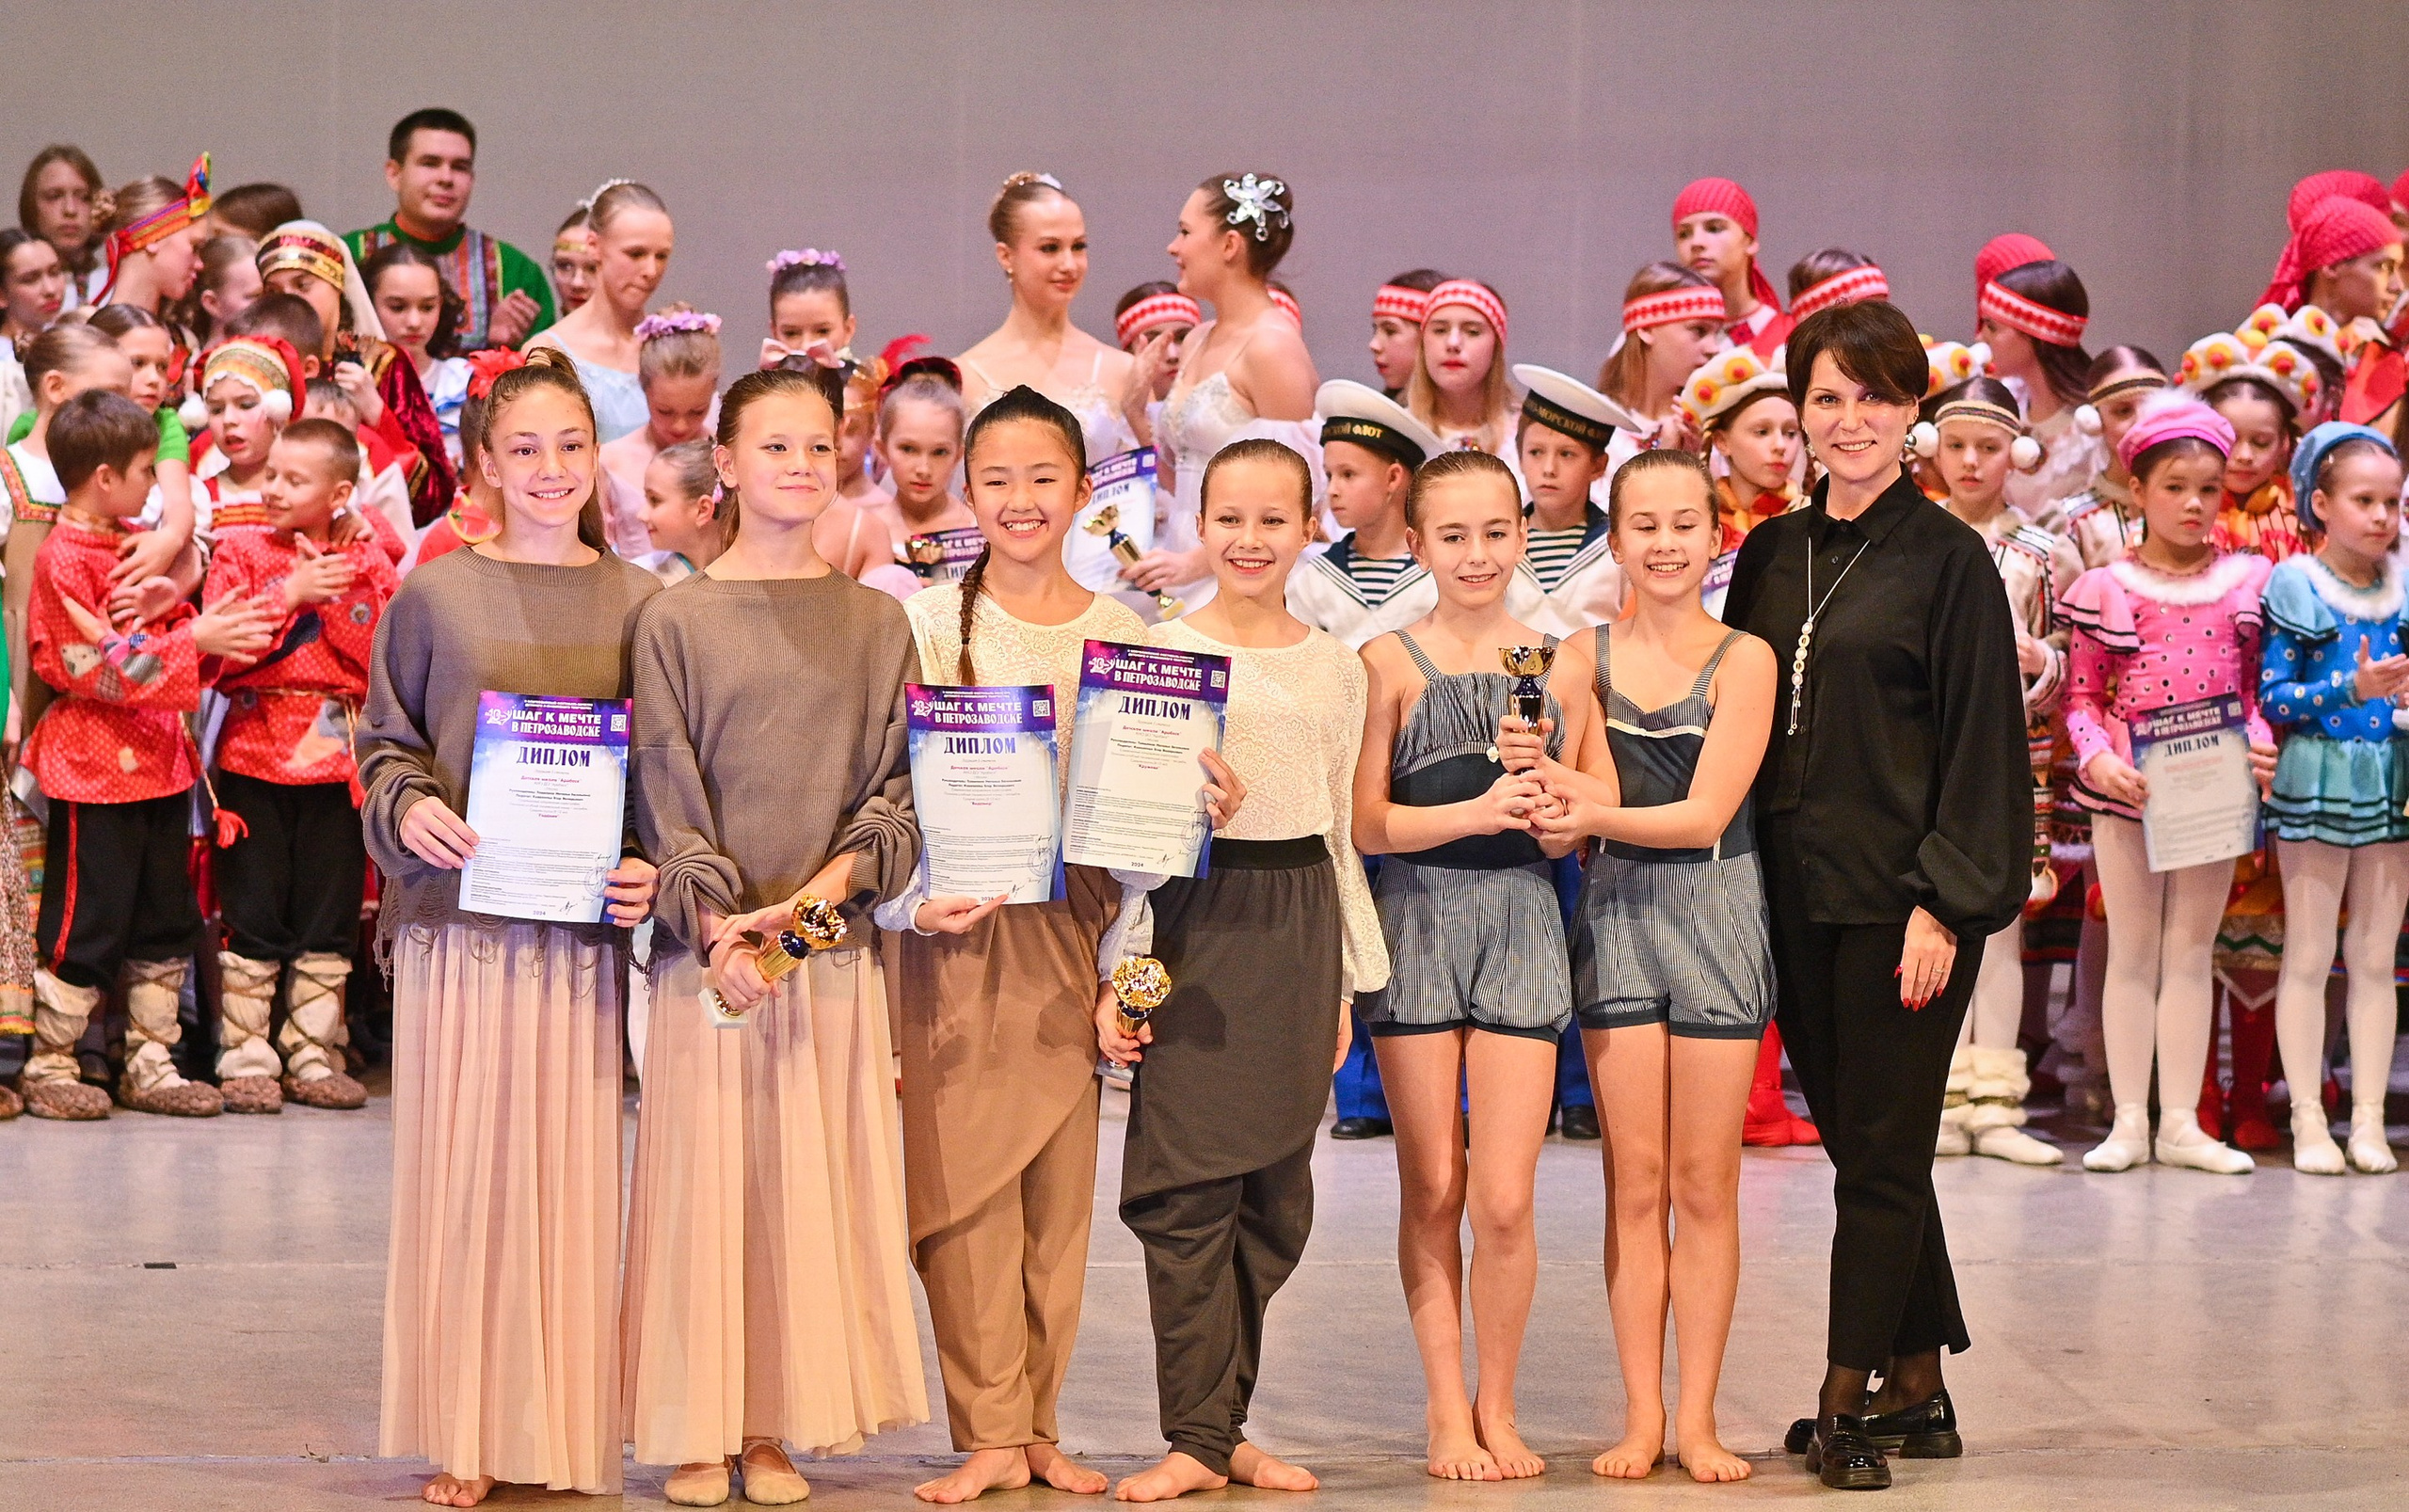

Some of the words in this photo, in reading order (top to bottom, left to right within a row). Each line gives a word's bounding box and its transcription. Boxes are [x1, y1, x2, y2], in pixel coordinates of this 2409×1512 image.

[1352, 423, 1383, 438] ФЛОТ
[1115, 658, 1145, 671] ШАГ
[1148, 662, 1158, 673] К
[1160, 664, 1203, 679] МЕЧТЕ
[1114, 671, 1122, 682] В
[1123, 672, 1202, 692] ПЕТРОЗАВОДСКЕ
[934, 701, 962, 712] ШАГ
[965, 702, 975, 712] К
[977, 701, 1023, 712] МЕЧТЕ
[1118, 696, 1191, 721] ДИПЛОМ
[512, 710, 543, 722] ШАГ
[546, 711, 555, 722] К
[558, 712, 602, 724] МЕЧТЕ
[934, 712, 942, 724] В
[942, 712, 1023, 724] ПЕТРОЗАВОДСКЕ
[511, 722, 519, 733] В
[520, 723, 600, 738] ПЕТРОЗАВОДСКЕ
[944, 737, 1016, 755] ДИПЛОМ
[516, 746, 591, 767] ДИПЛОМ
